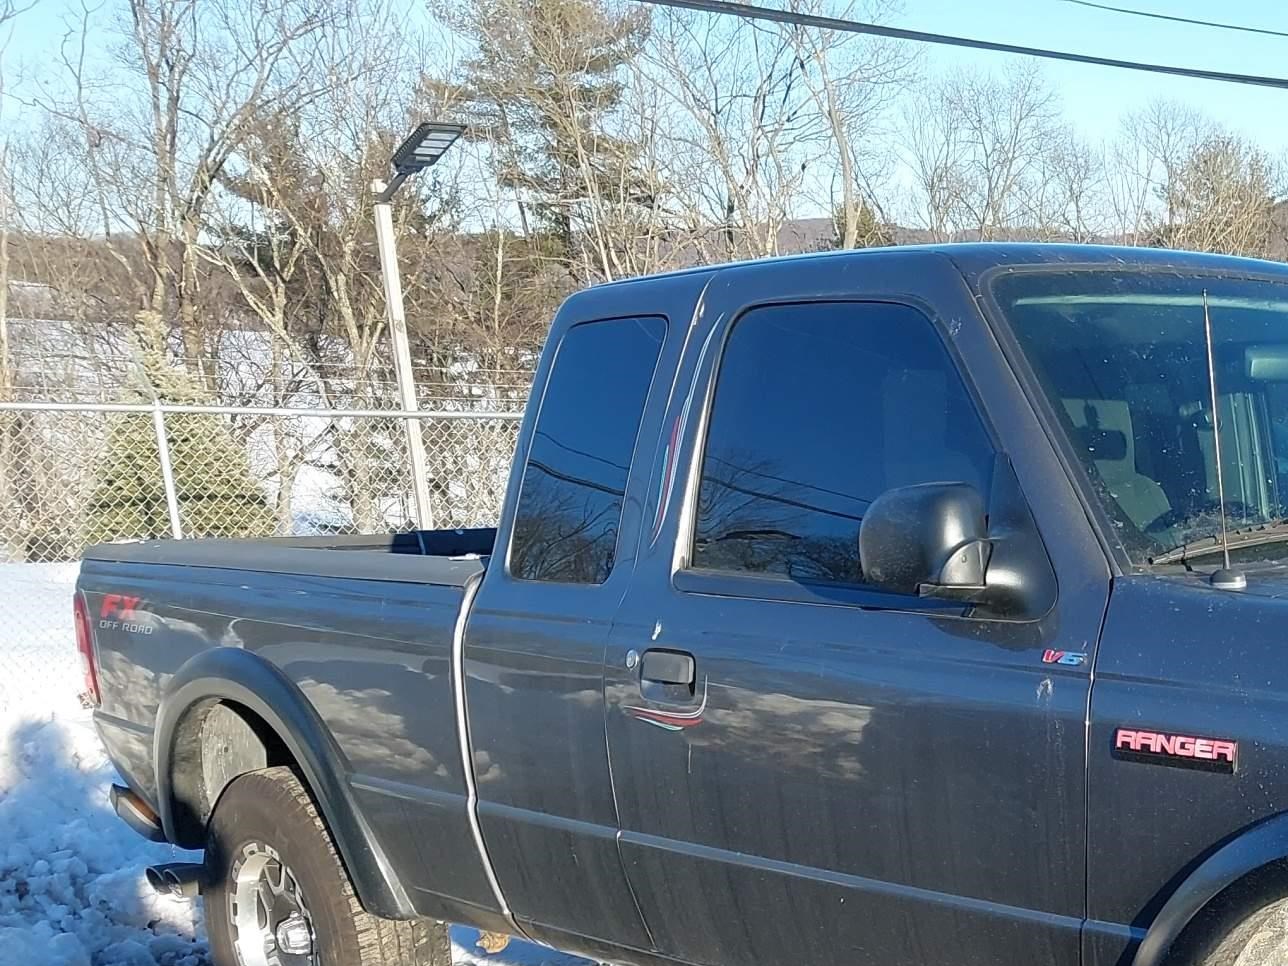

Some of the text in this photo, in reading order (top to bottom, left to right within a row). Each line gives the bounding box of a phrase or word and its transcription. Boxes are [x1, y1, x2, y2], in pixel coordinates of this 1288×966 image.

[99, 619, 153, 635] OFF ROAD
[1116, 729, 1235, 761] RANGER
